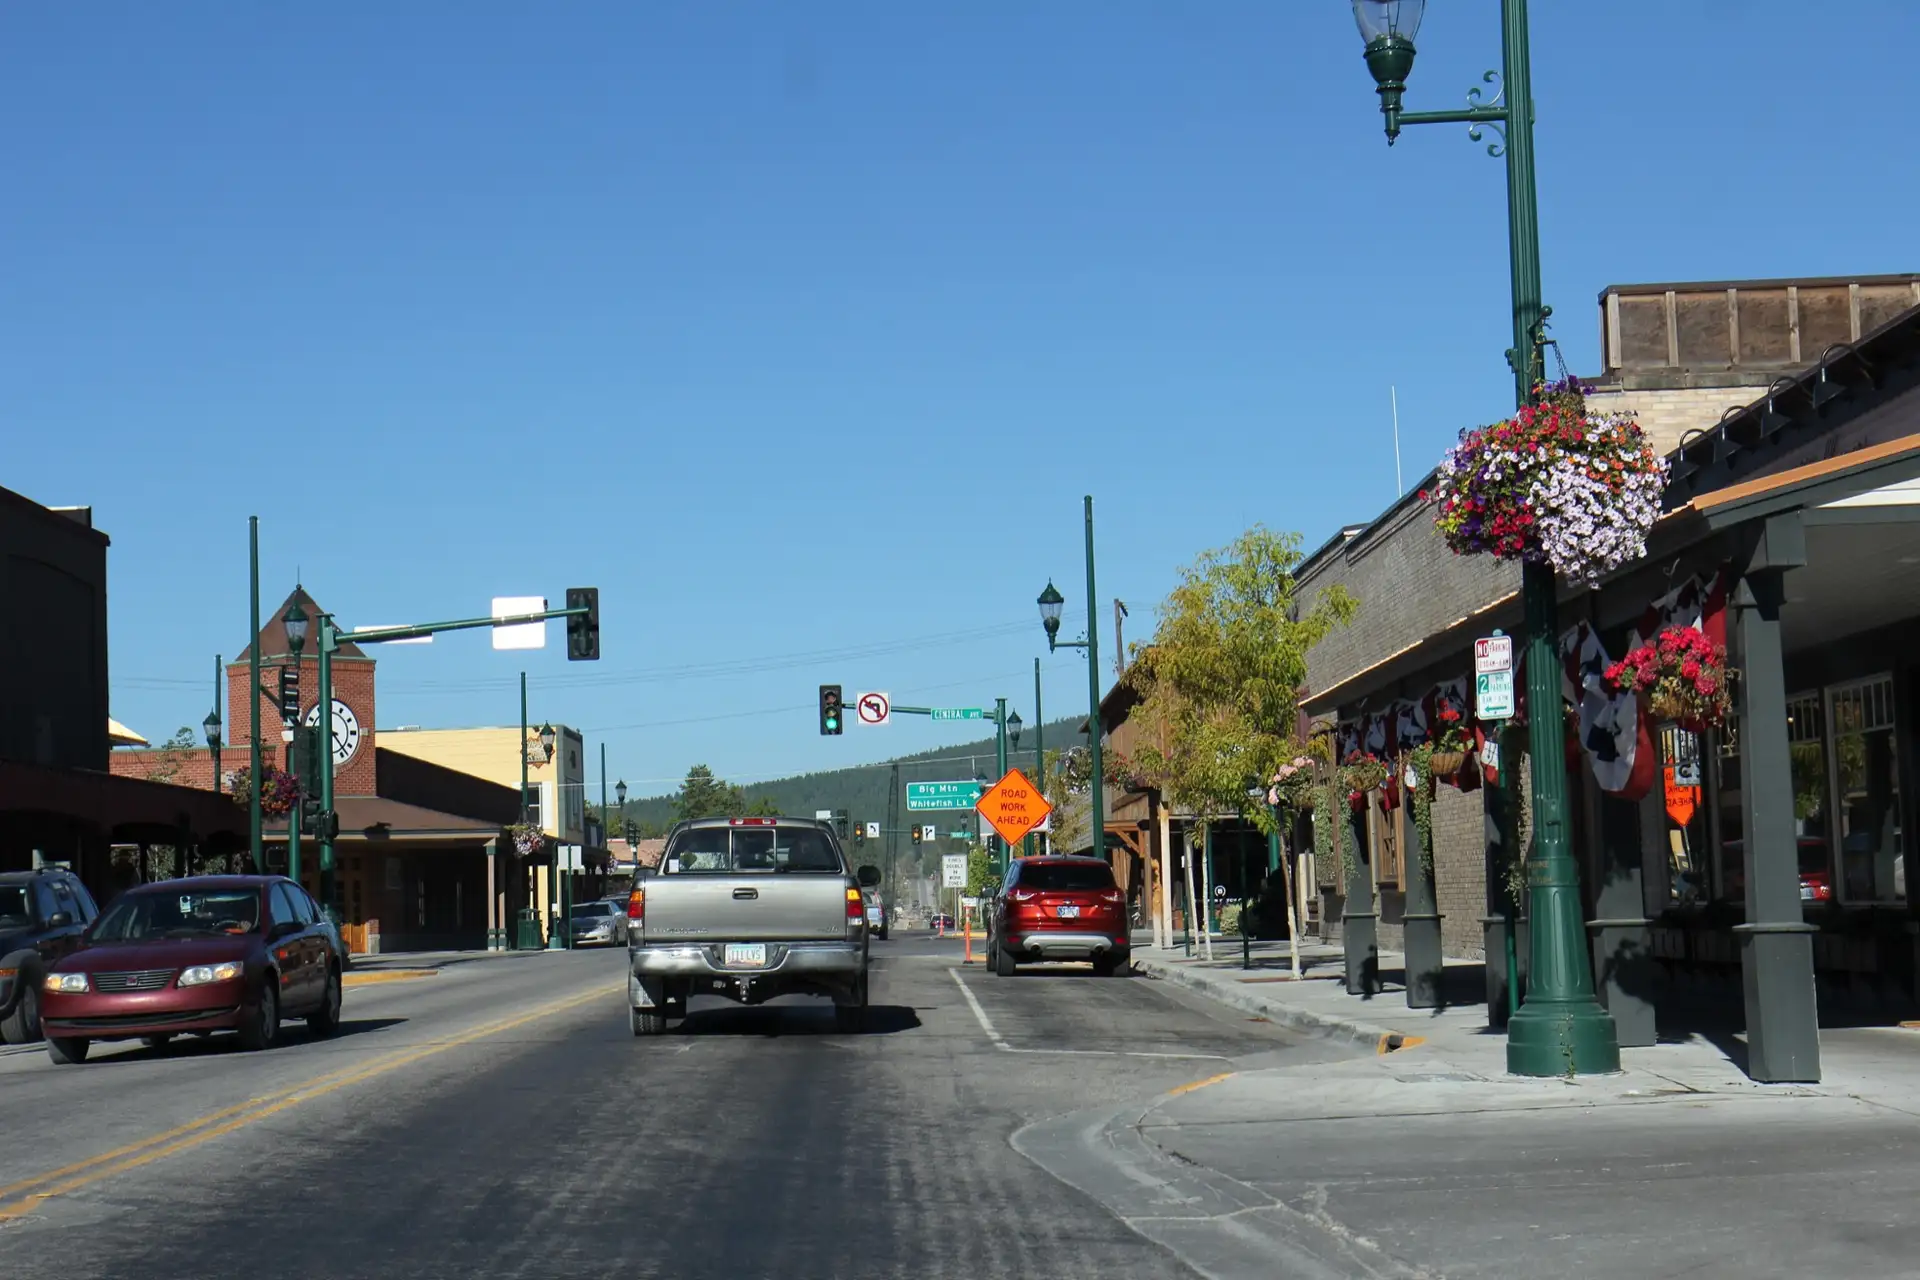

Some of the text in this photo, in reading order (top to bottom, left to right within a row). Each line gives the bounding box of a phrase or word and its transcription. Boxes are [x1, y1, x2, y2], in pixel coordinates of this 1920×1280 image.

[1477, 643, 1488, 657] NO
[1480, 676, 1488, 693] 2
[934, 709, 964, 719] CENTRAL
[919, 784, 958, 795] Big Mtn
[1001, 788, 1027, 799] ROAD
[910, 799, 953, 808] Whitefish
[1000, 802, 1026, 812] WORK
[996, 815, 1030, 826] AHEAD
